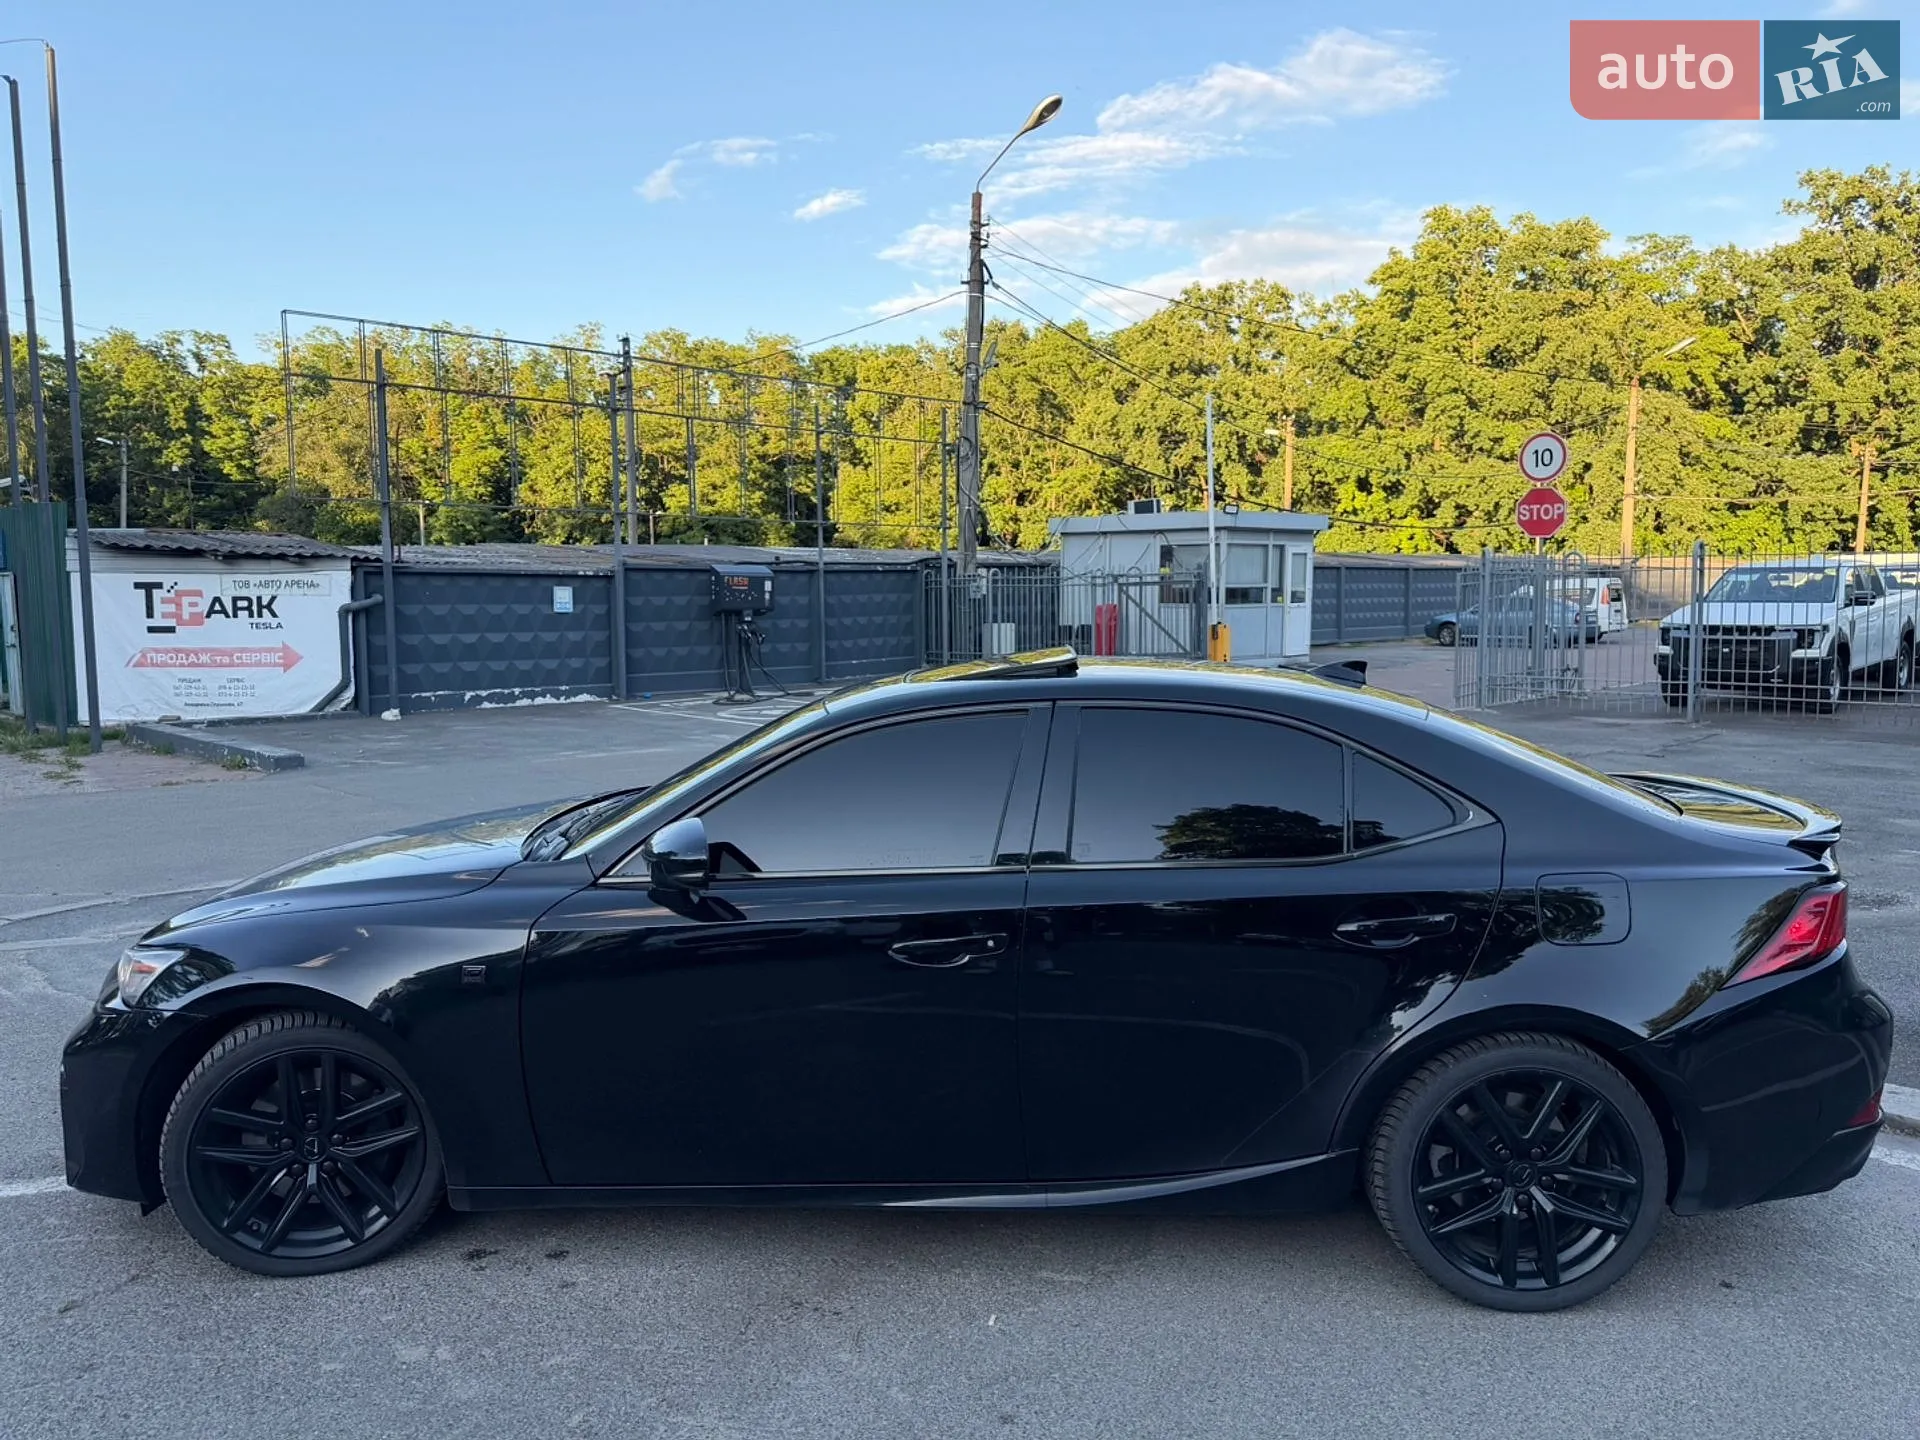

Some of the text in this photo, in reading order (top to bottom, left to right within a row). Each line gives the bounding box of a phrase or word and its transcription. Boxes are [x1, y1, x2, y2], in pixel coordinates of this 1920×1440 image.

[1532, 448, 1554, 468] 10
[1518, 504, 1564, 521] STOP
[232, 579, 251, 589] ТОВ
[249, 622, 284, 630] TESLA
[146, 652, 211, 665] ПРОДАЖ
[233, 652, 284, 664] СЕРВІС
